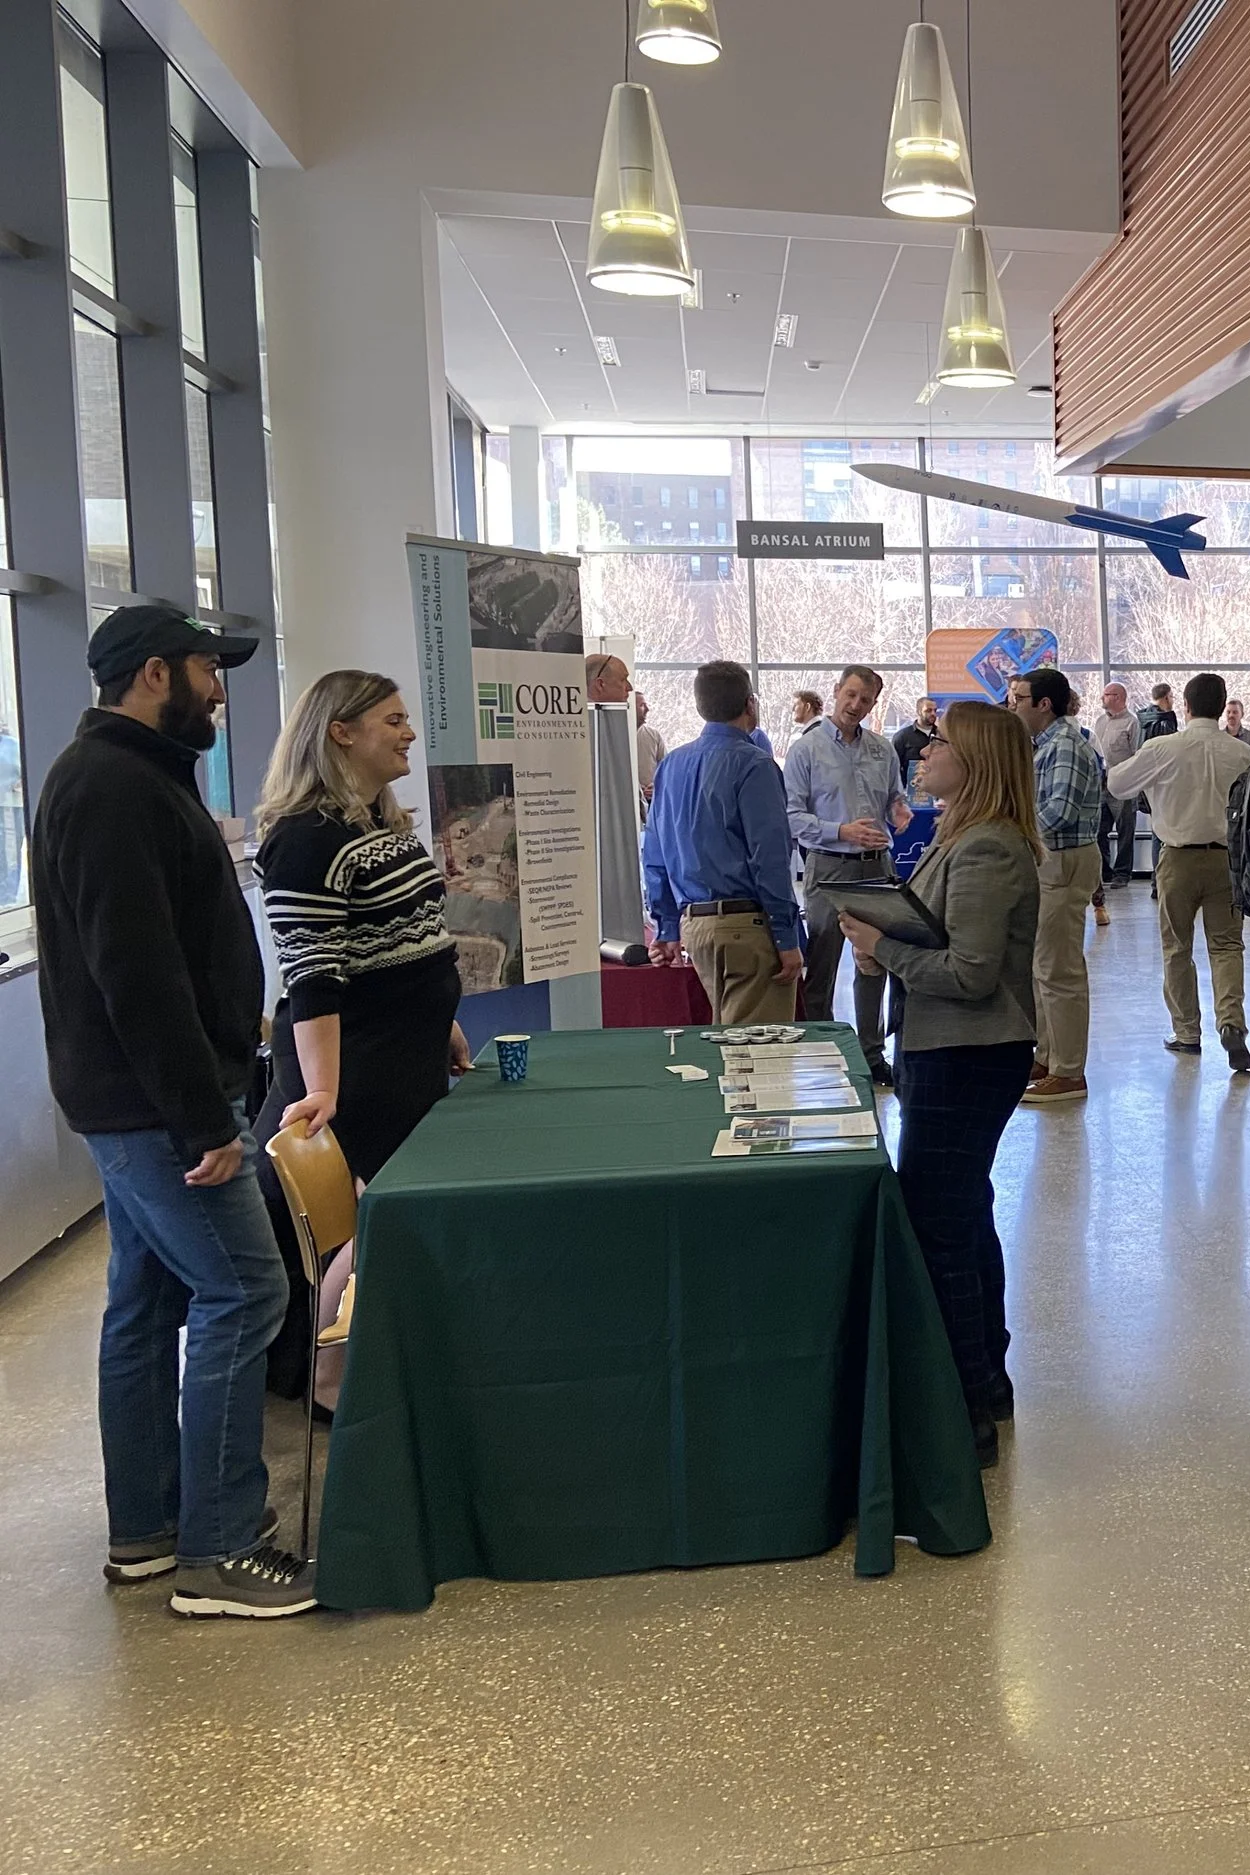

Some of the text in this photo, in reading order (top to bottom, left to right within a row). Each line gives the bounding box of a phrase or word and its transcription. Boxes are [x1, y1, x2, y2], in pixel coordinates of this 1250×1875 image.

[751, 534, 871, 547] BANSAL ATRIUM
[419, 553, 436, 749] Innovative Engineering and
[432, 554, 448, 730] Environmental Solutions
[515, 684, 583, 715] CORE
[516, 720, 585, 728] ENVIRONMENTAL
[517, 731, 586, 739] CONSULTANTS
